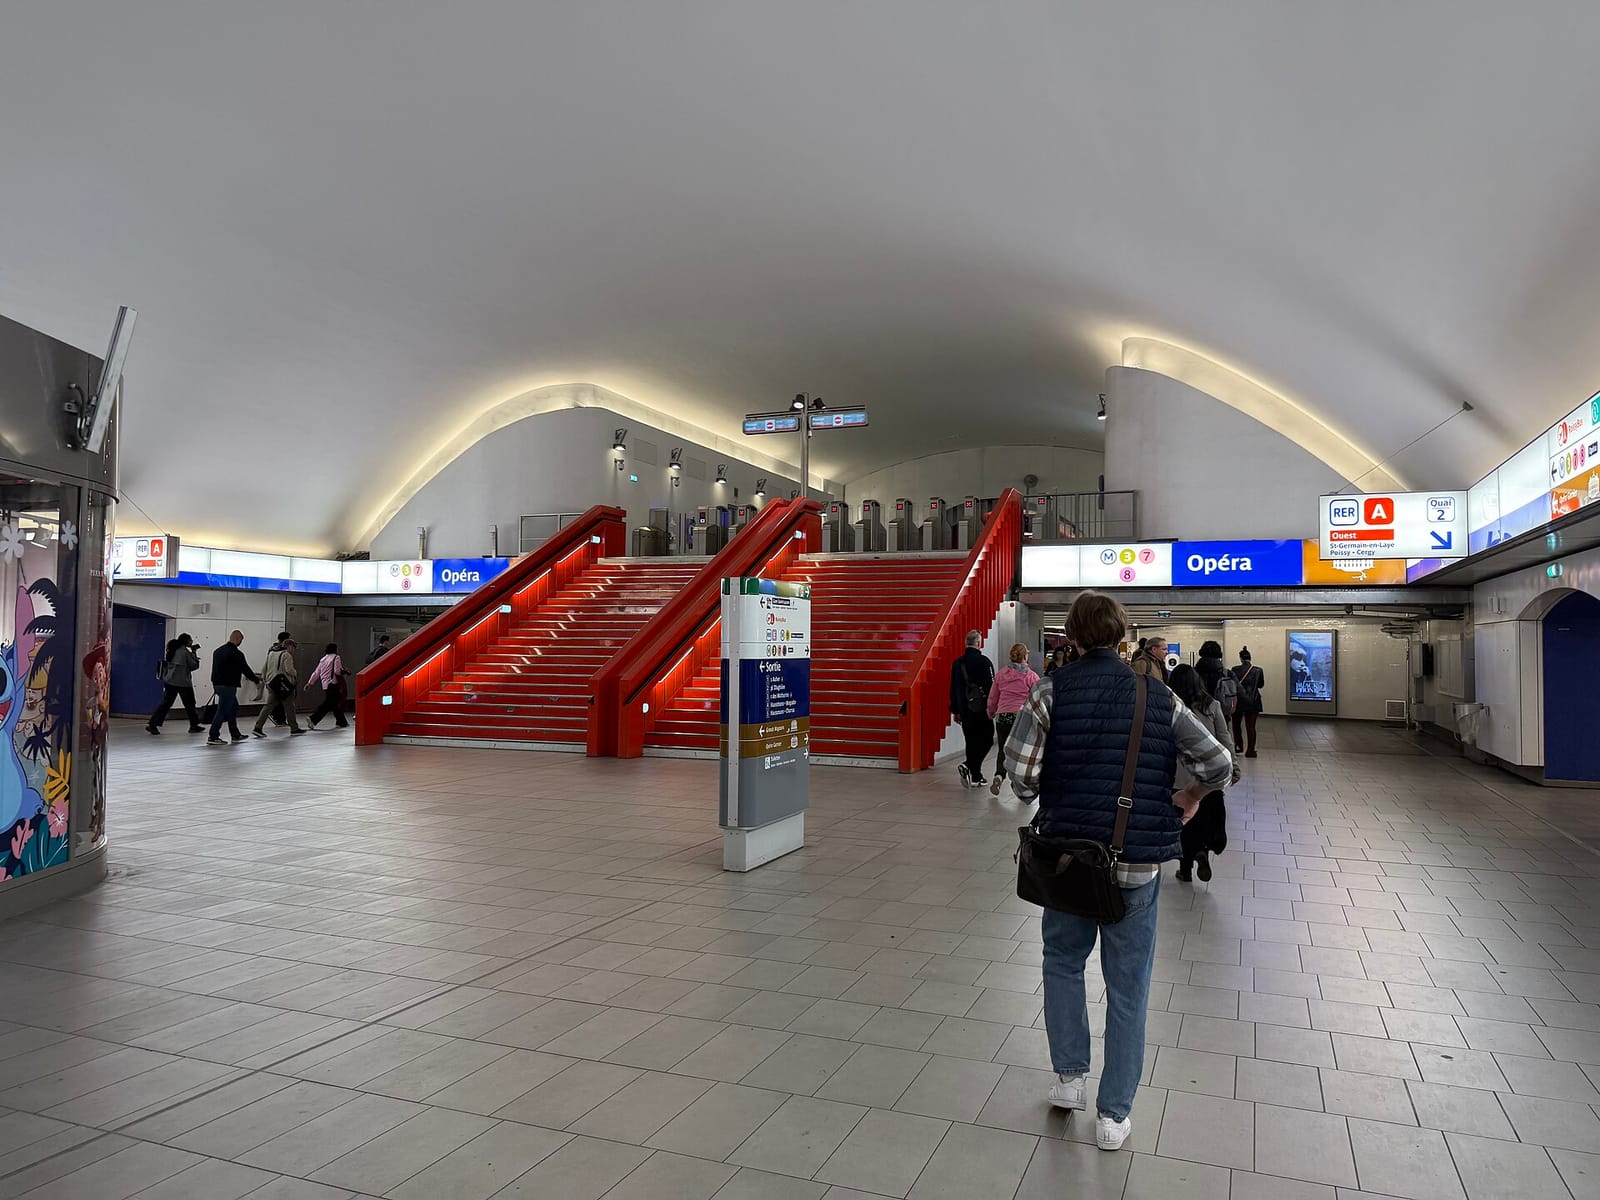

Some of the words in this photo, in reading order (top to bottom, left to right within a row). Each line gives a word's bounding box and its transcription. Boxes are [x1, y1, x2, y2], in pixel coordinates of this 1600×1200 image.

[1430, 499, 1451, 508] Quai
[1333, 507, 1355, 518] RER
[1371, 503, 1387, 519] A
[1437, 509, 1445, 521] 2
[1332, 532, 1357, 540] Ouest
[153, 543, 161, 553] A
[1330, 542, 1395, 550] St-Germain-en-Laye
[1103, 552, 1114, 561] M
[1124, 552, 1131, 562] 3
[1143, 551, 1151, 561] 7
[1330, 549, 1351, 557] Poissy
[1356, 549, 1375, 557] Cergy
[1187, 553, 1252, 575] Opéra
[403, 566, 410, 575] 3
[415, 566, 421, 575] 7
[1123, 569, 1131, 580] 8
[441, 568, 480, 584] Opéra
[403, 579, 409, 589] 8
[765, 661, 781, 673] Sortie
